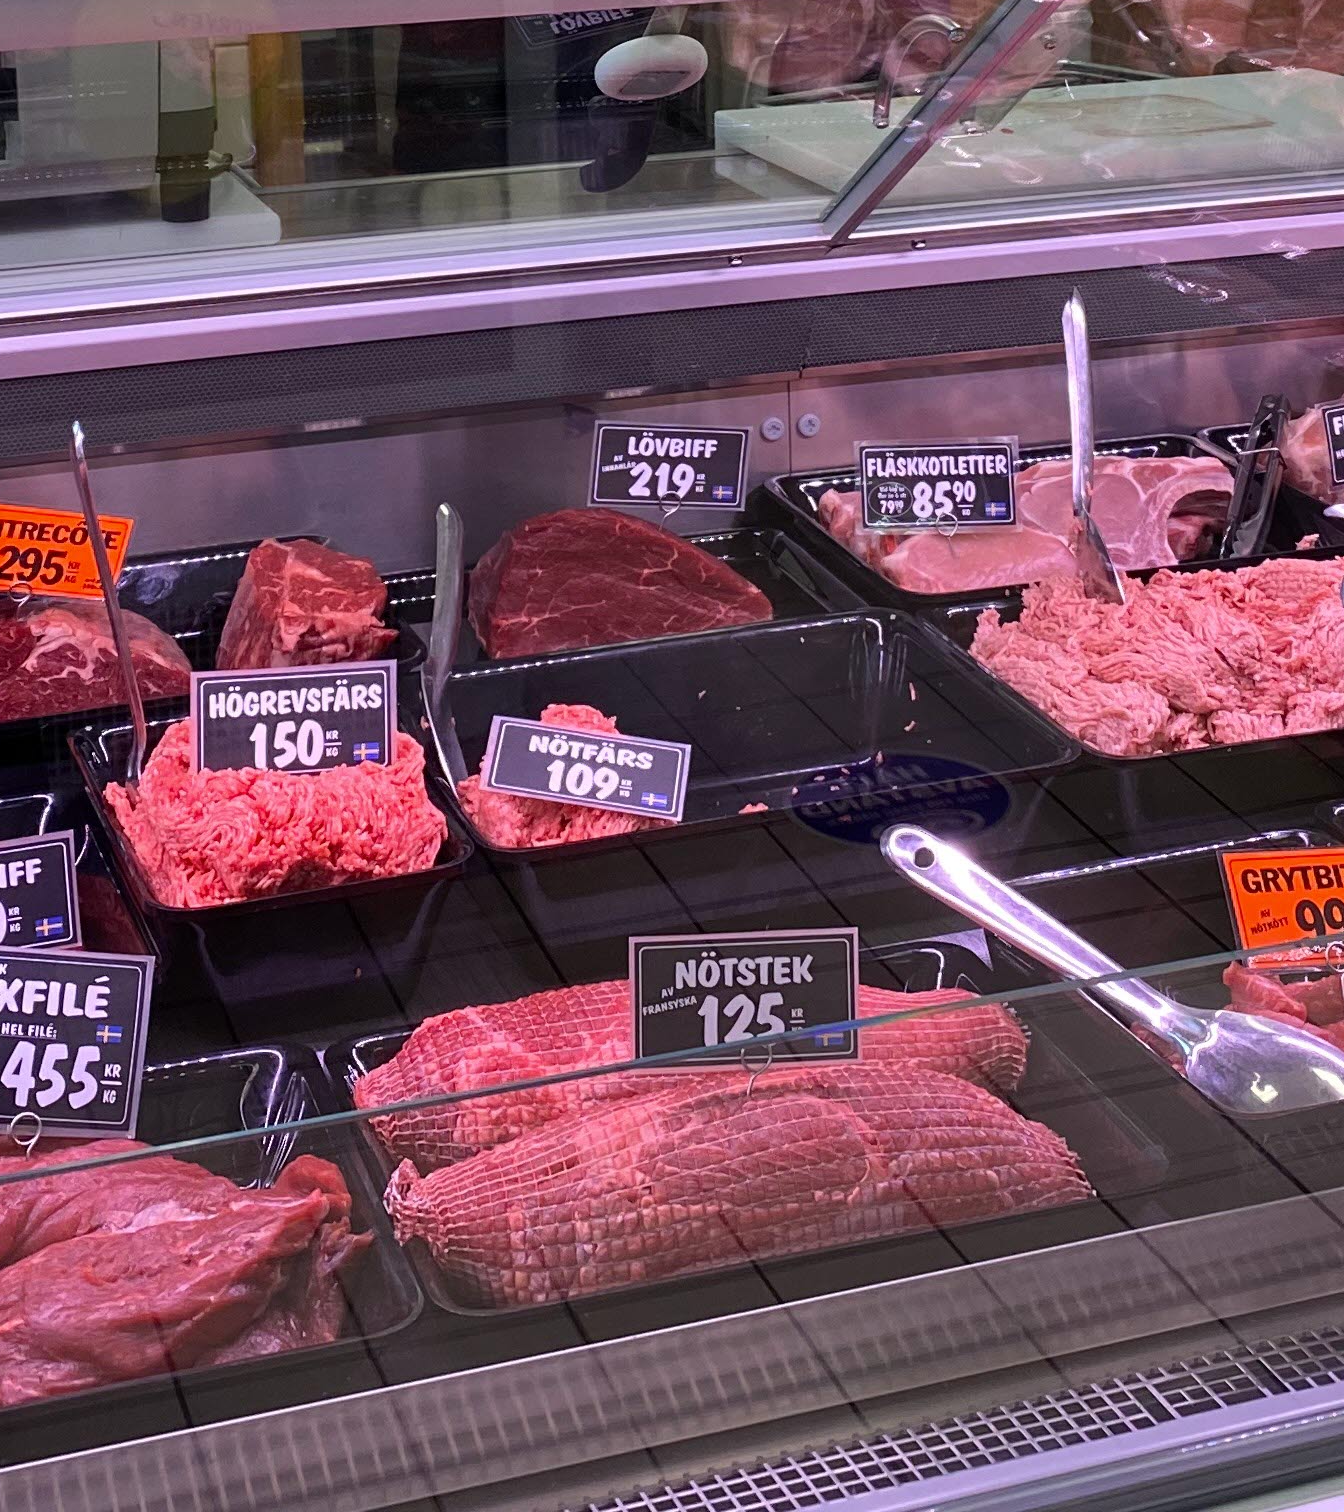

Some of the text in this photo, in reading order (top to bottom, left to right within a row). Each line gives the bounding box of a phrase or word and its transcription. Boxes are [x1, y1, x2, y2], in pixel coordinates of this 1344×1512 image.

[627, 431, 719, 459] LÖVBIFF
[628, 461, 695, 499] 219
[866, 452, 1008, 478] FLÄSKKOTLETTER
[209, 678, 383, 719] HÖGREVSFÄRS
[249, 719, 325, 769] 150
[528, 734, 654, 770] NÖTFÄRS
[546, 759, 620, 800] 109
[674, 950, 814, 990] NÖTSTEK
[642, 995, 698, 1017] FRANSYSKA
[660, 987, 674, 999] AV
[1, 1023, 26, 1037] HEL
[697, 992, 786, 1048] 125
[0, 1040, 102, 1110] 455
